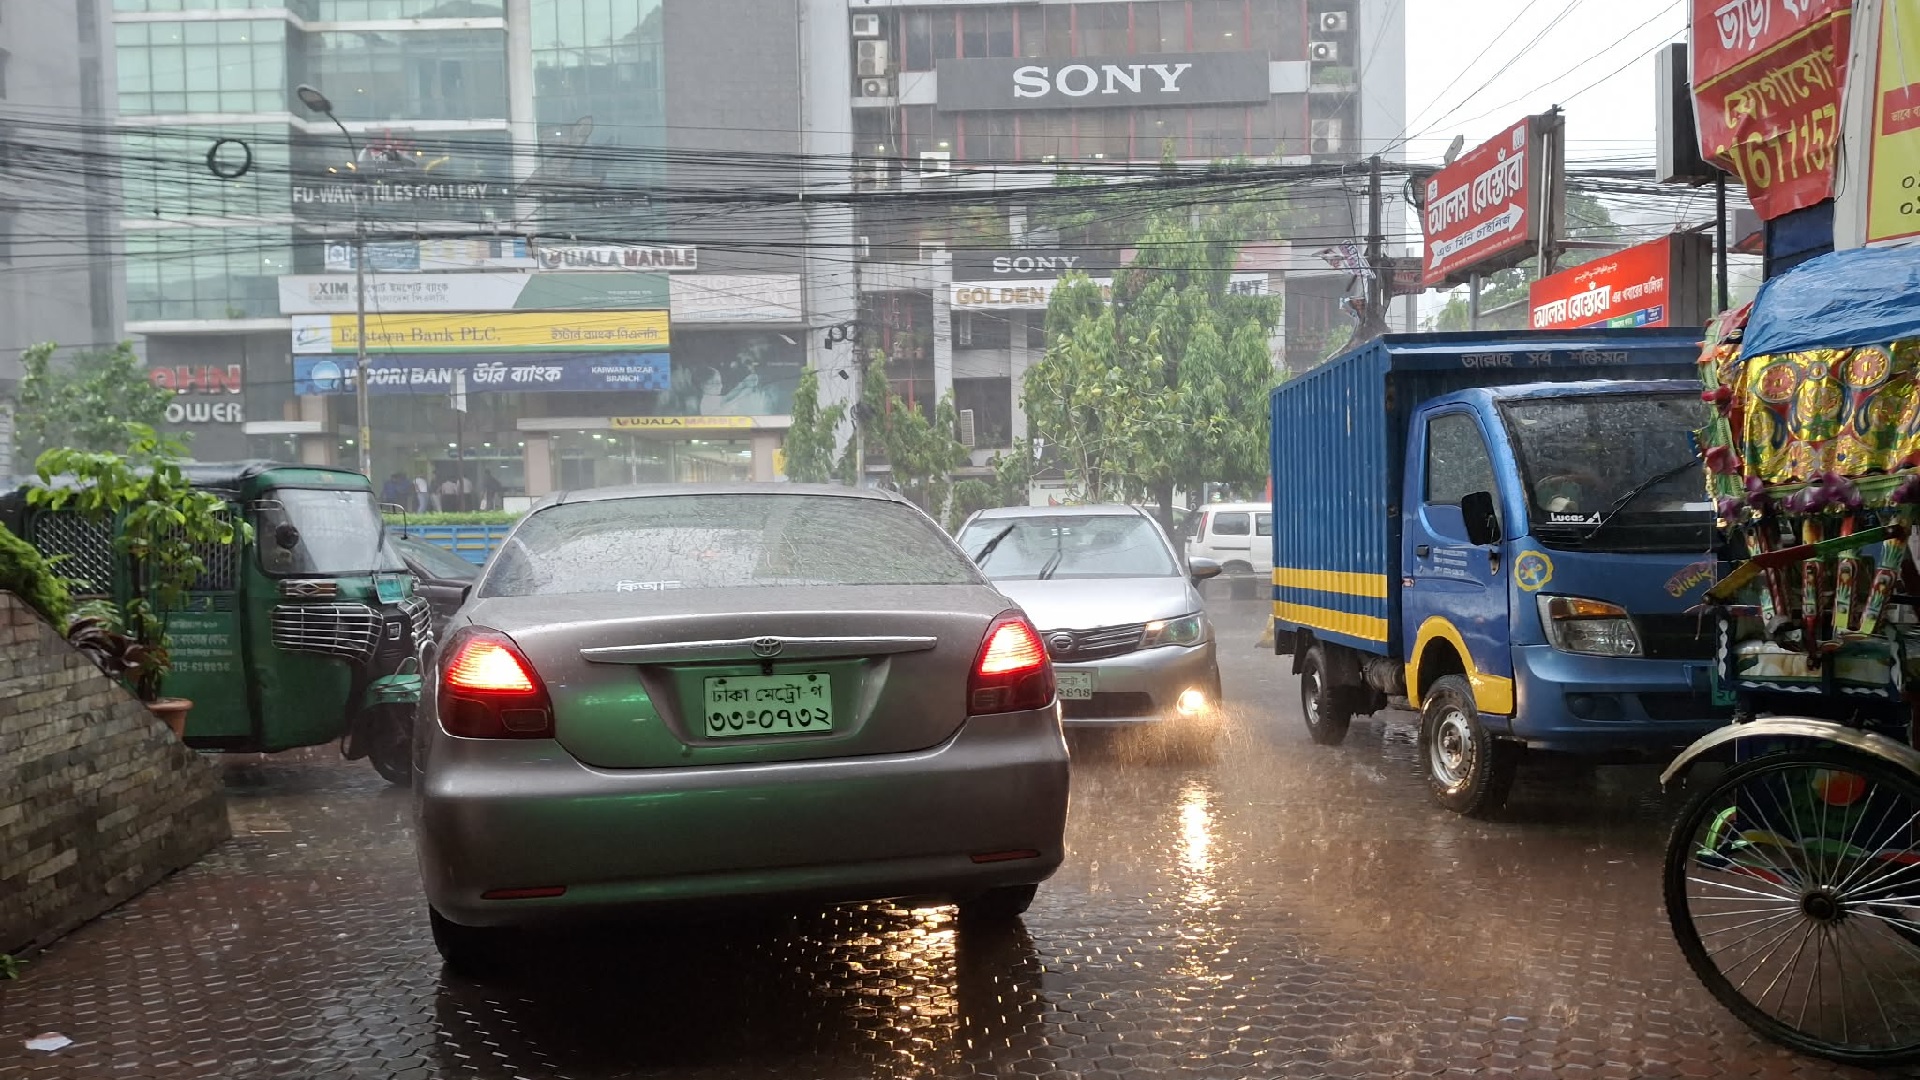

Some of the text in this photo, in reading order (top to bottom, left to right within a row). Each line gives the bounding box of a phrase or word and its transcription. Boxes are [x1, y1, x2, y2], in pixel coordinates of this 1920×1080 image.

[1012, 63, 1193, 98] SONY
[372, 184, 413, 201] TILES
[415, 183, 488, 200] GALLERY
[1428, 183, 1469, 236] আলম
[624, 248, 696, 267] MARBLE
[993, 256, 1080, 274] SONY
[956, 286, 1045, 305] GOLDEN
[1533, 299, 1567, 328] আলম
[341, 327, 405, 342] Eastern
[411, 326, 454, 341] Bank
[511, 363, 563, 383] ব্যাংক
[606, 374, 640, 383] BRANCH
[626, 366, 653, 374] BAZAR
[165, 402, 242, 423] OWER
[630, 417, 682, 426] UJALA
[1550, 512, 1585, 522] Lucas
[712, 685, 749, 703] ঢাকা
[708, 707, 831, 732] ৩৩-০৭৩২
